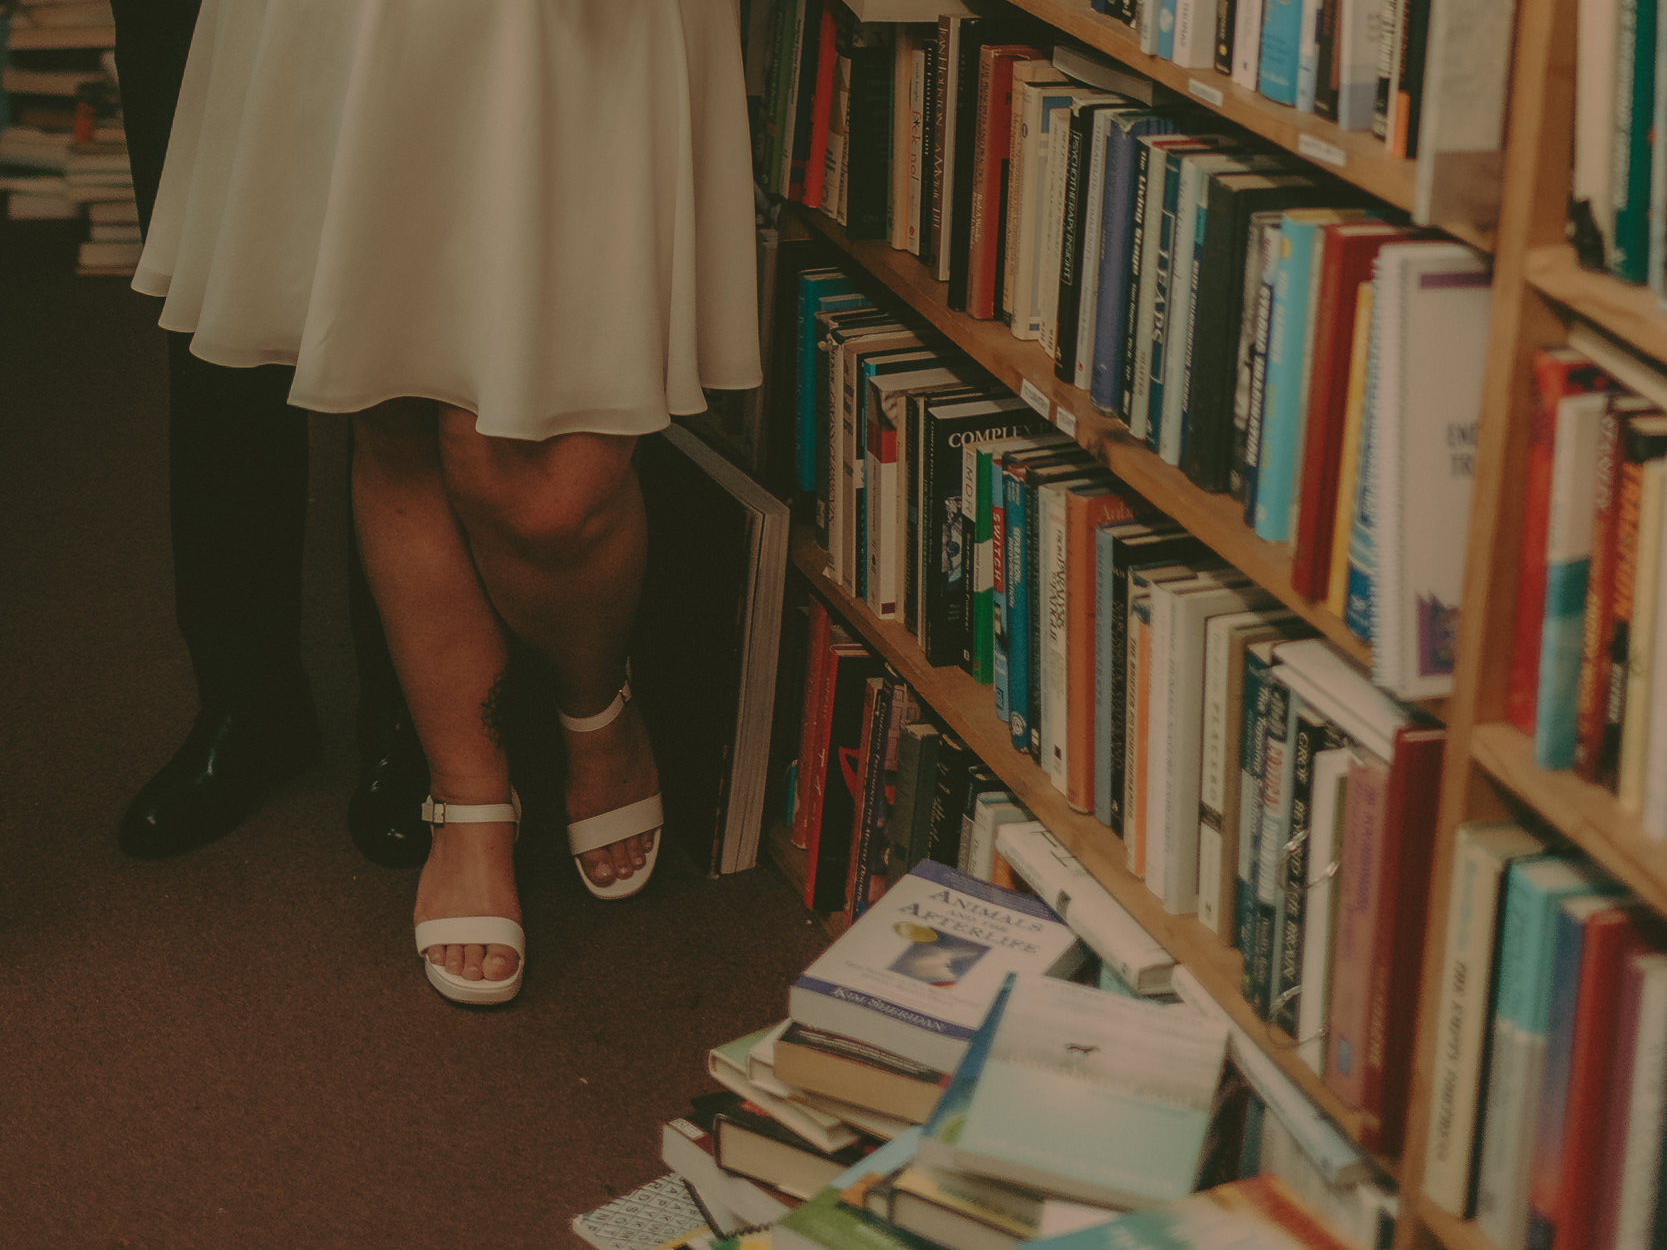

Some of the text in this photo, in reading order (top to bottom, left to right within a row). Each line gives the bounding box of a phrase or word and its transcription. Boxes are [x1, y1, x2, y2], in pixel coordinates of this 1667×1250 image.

[1061, 135, 1080, 280] PSYCHOTHERAPY INSIGHT
[1130, 151, 1148, 276] The Living Stage
[962, 451, 974, 514] EMDR
[993, 512, 1001, 582] SWITCH
[1296, 732, 1309, 785] GROF
[898, 902, 1040, 954] AFTERLIFE
[928, 890, 1043, 932] ANIMALS
[1285, 919, 1300, 979] BRAIN
[833, 988, 946, 1030] KIM SHERIDAN
